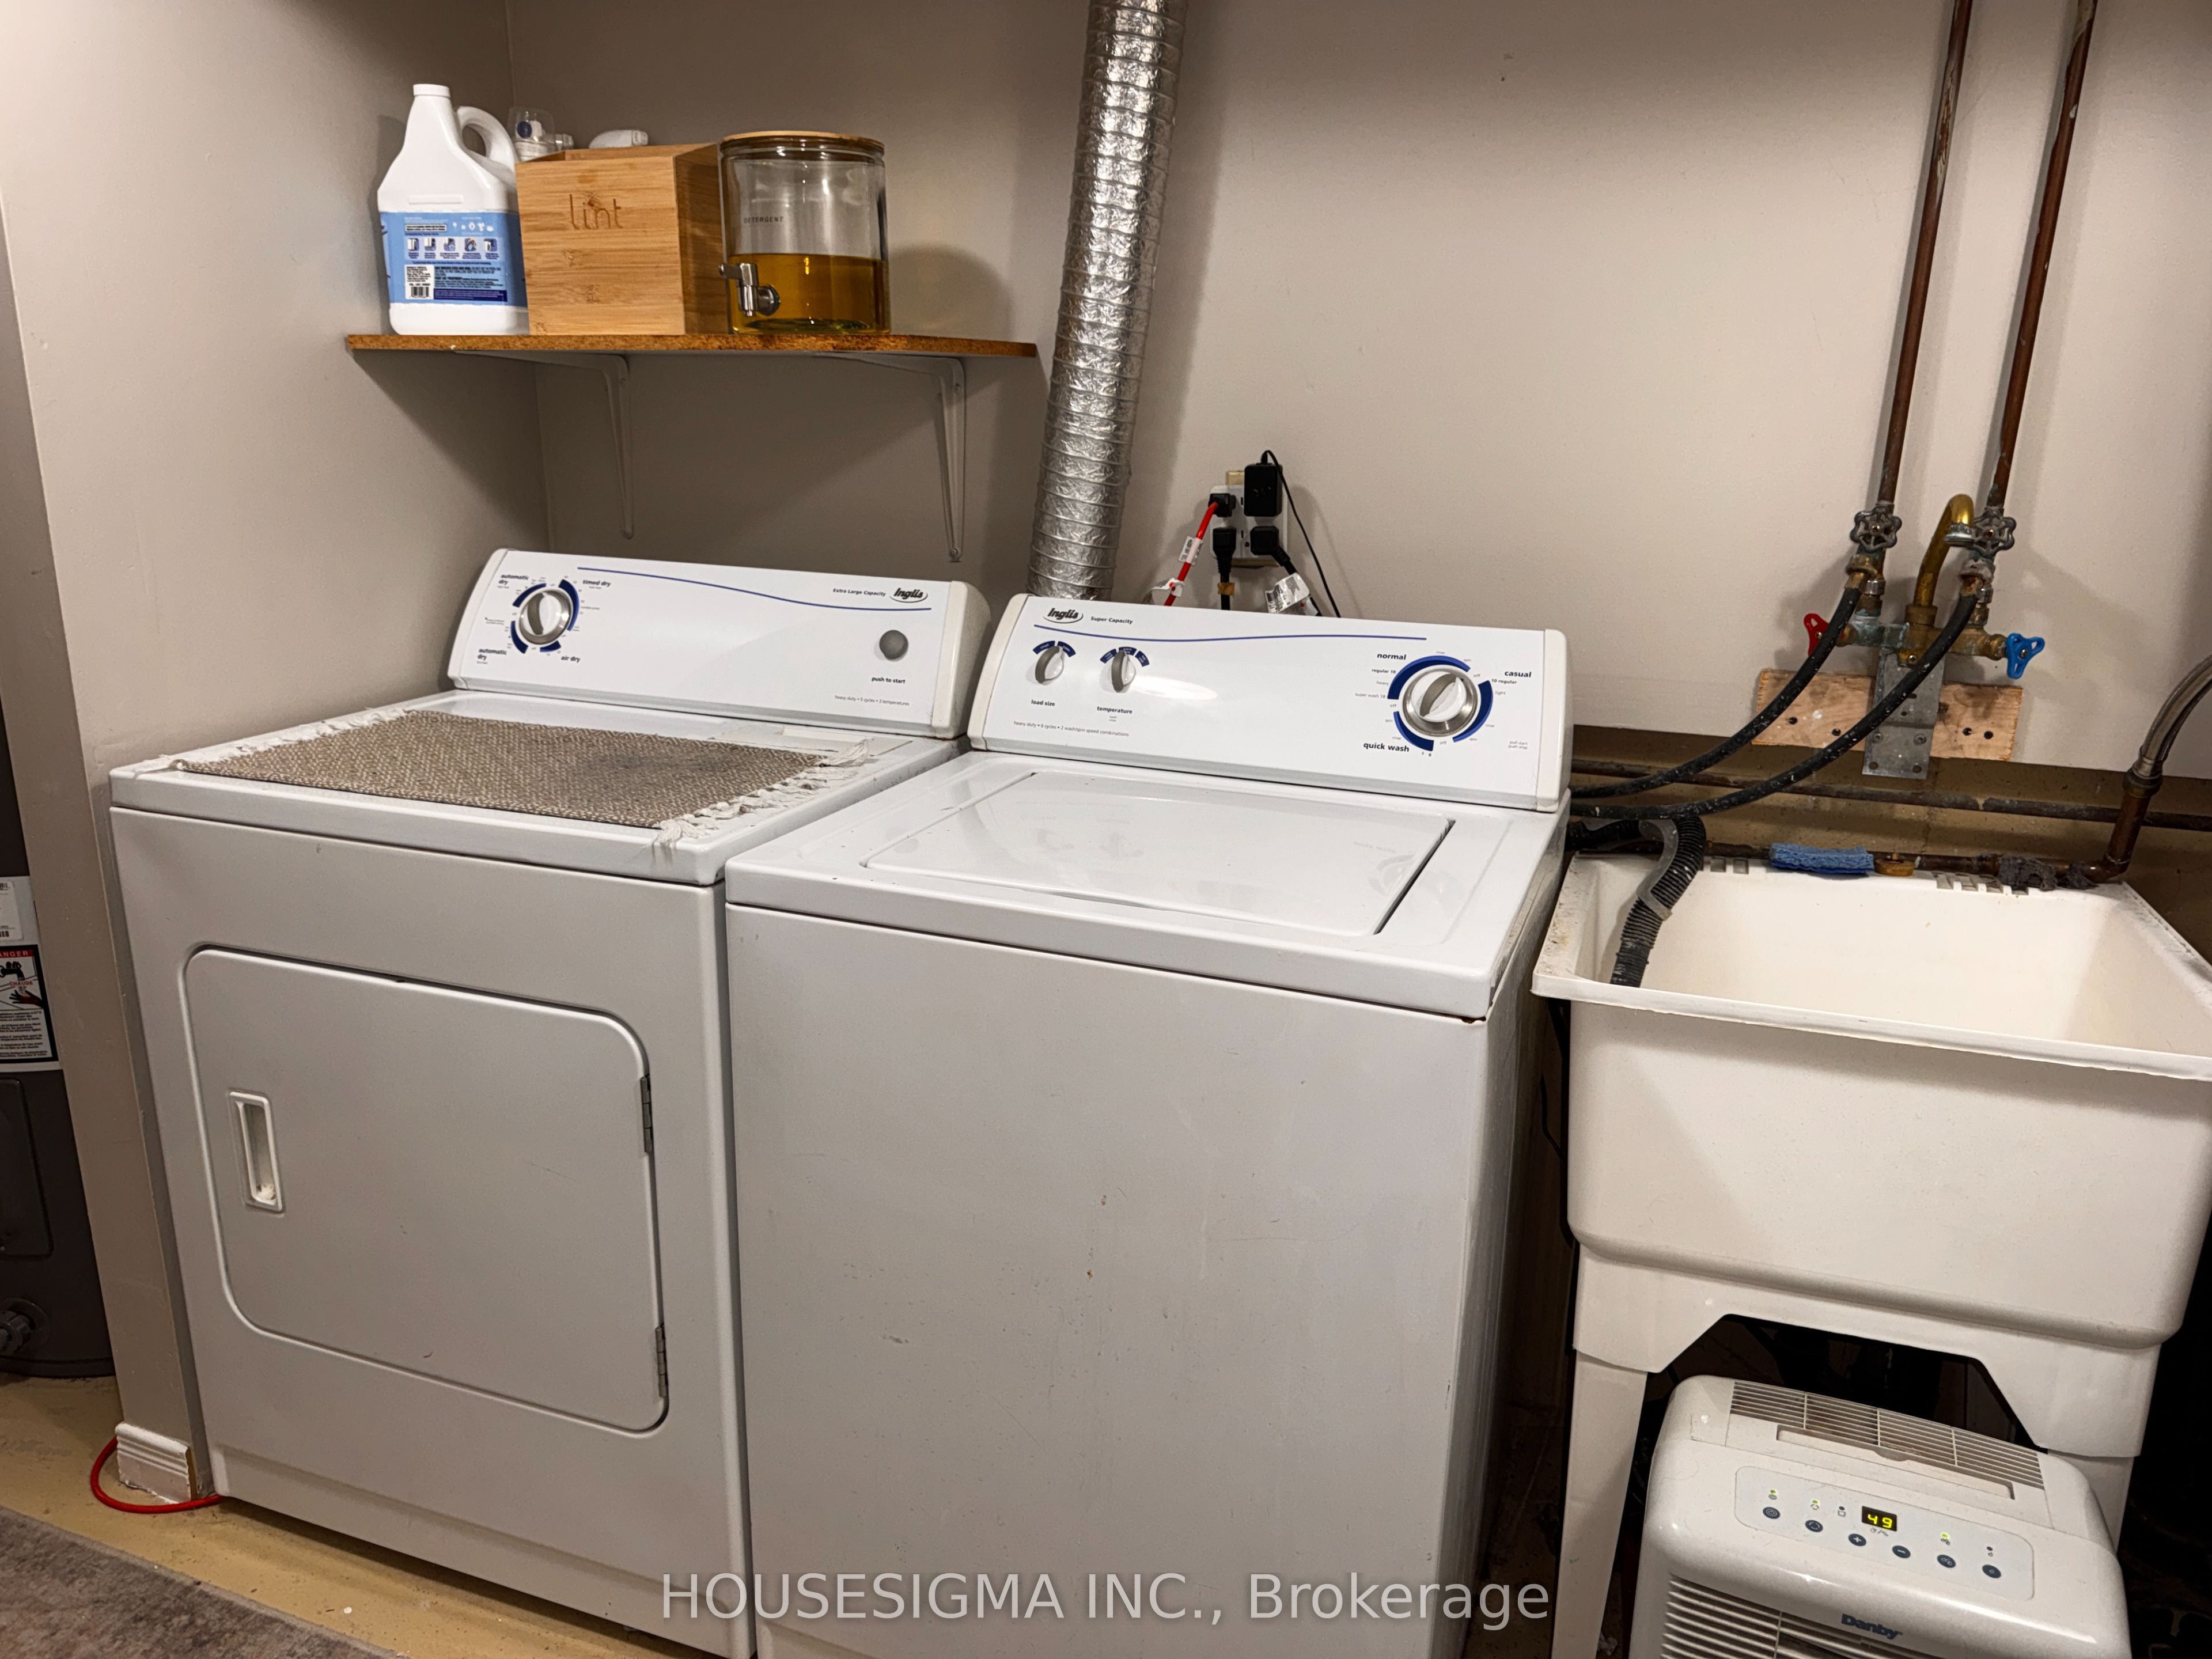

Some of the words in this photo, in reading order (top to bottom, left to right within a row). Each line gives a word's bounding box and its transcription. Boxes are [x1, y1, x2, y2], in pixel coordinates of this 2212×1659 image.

[569, 194, 623, 230] lint
[743, 215, 784, 224] DETERGENT
[893, 588, 923, 600] Inglis
[1047, 608, 1079, 620] Inglis
[570, 656, 581, 664] dry
[1097, 706, 1132, 714] temperature
[1363, 742, 1385, 750] quick
[1868, 1513, 1893, 1529] 49
[1841, 1613, 1900, 1640] Danby
